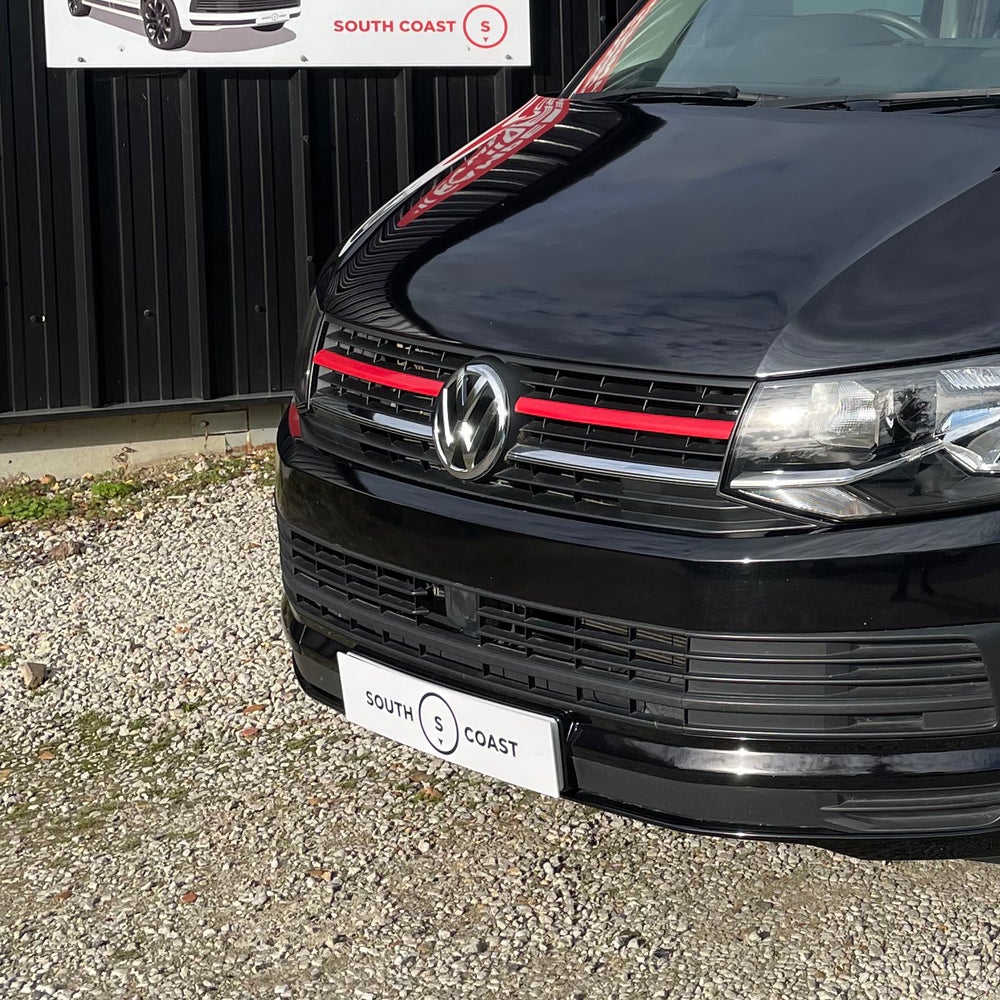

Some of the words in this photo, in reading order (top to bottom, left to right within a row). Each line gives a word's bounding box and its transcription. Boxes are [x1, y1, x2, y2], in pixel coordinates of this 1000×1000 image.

[333, 19, 395, 33] SOUTH
[398, 19, 457, 33] COAST
[480, 20, 491, 33] S
[365, 690, 414, 722] SOUTH
[434, 715, 444, 732] S
[464, 726, 518, 758] COAST
